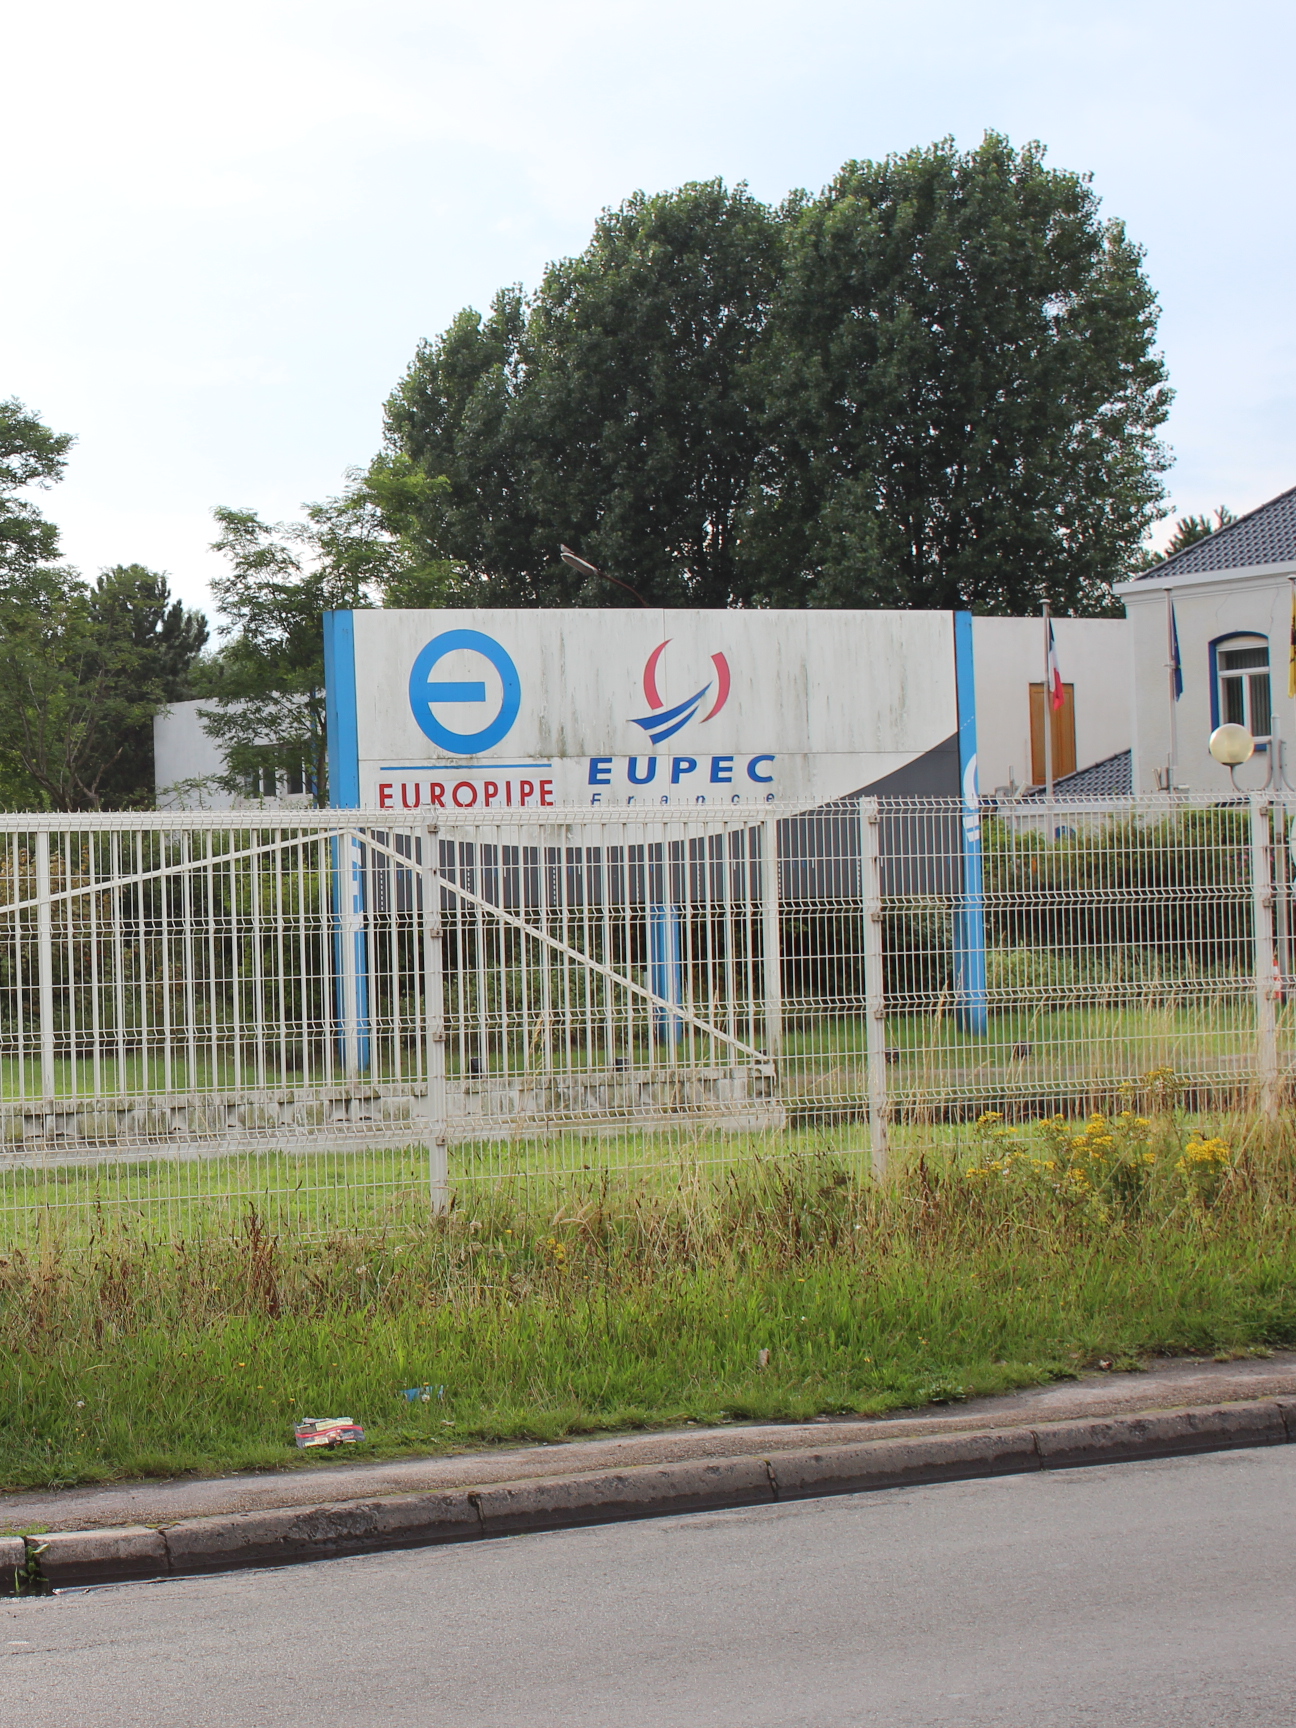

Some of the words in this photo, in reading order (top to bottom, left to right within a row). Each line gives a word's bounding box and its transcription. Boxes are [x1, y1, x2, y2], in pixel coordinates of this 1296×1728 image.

[588, 755, 776, 786] EUPEC
[379, 779, 555, 811] EUROPIPE
[591, 793, 775, 805] France
